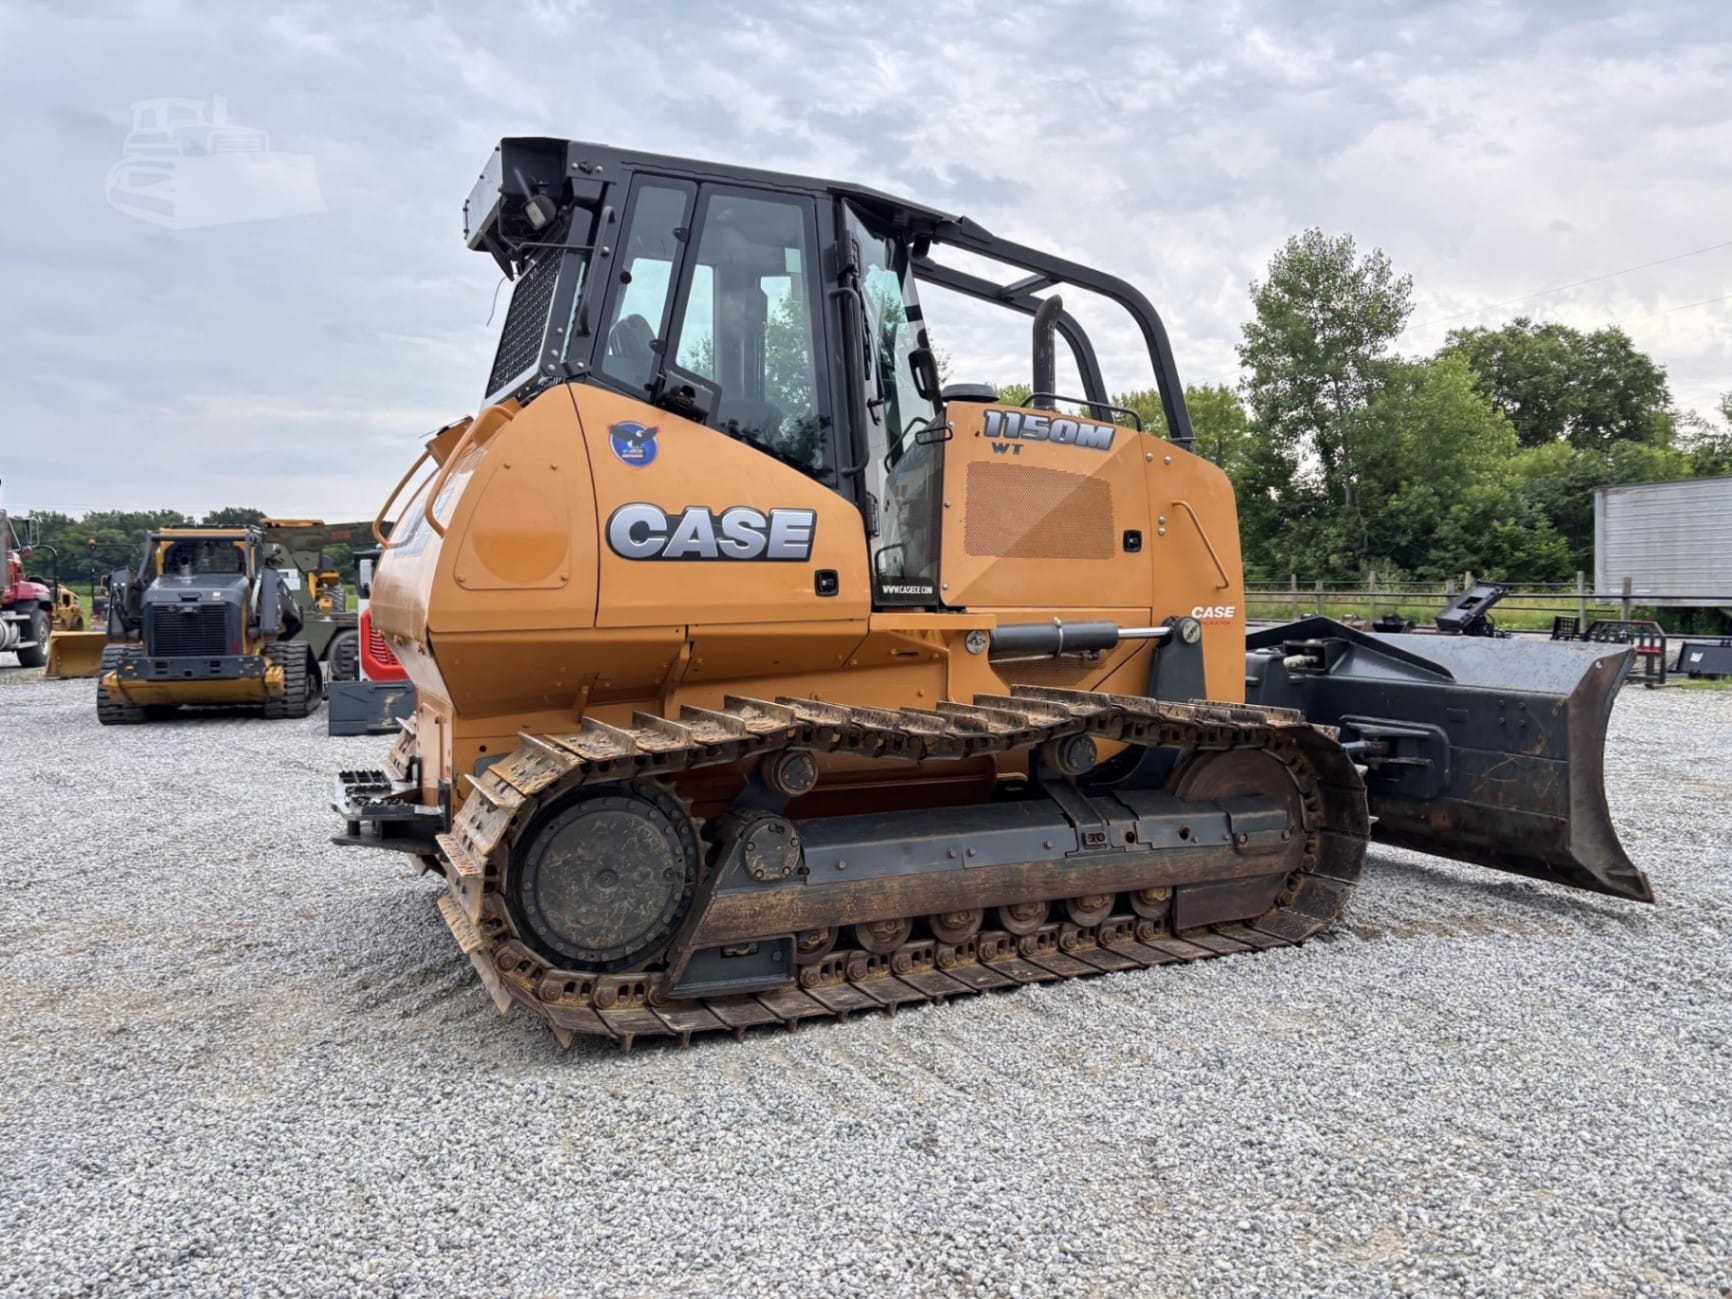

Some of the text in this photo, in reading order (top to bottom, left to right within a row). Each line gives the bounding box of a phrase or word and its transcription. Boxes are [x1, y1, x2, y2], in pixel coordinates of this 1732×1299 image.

[984, 409, 1116, 451] 1150M
[991, 442, 1024, 455] WT
[606, 503, 817, 561] CASE
[1191, 606, 1236, 619] CASE
